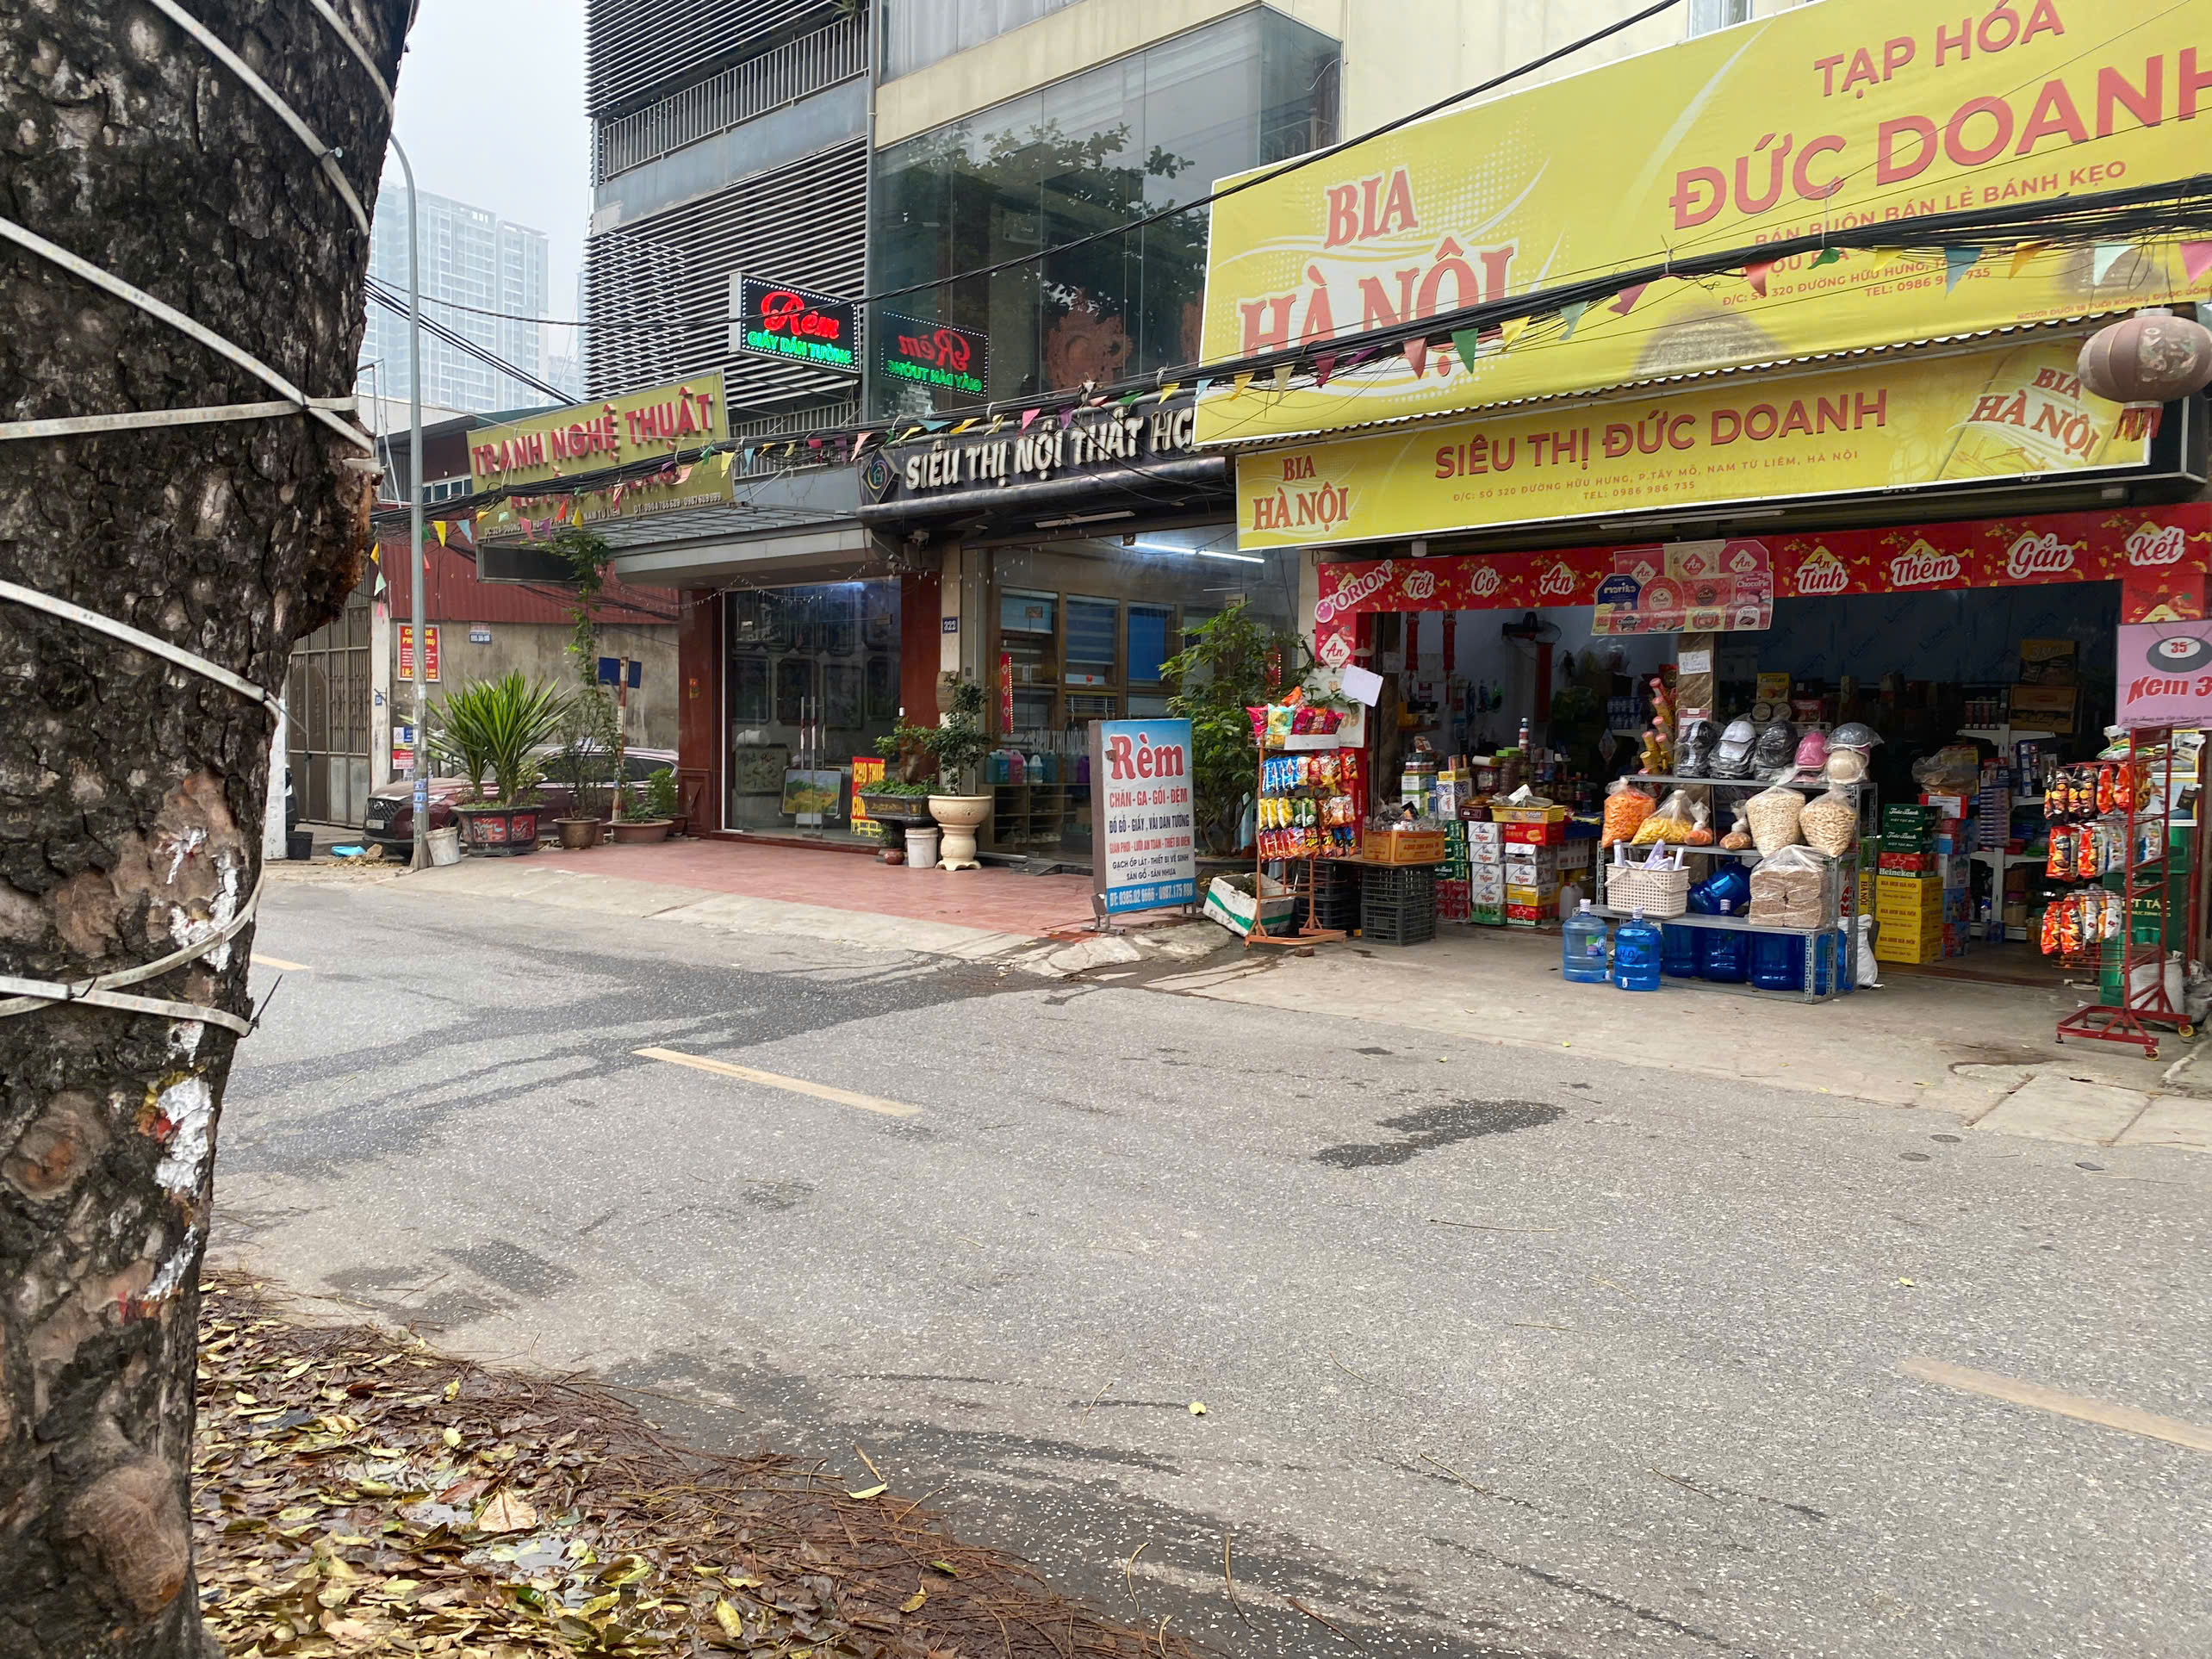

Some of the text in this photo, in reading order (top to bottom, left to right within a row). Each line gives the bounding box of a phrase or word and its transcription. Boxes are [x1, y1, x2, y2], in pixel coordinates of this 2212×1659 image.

[1814, 0, 2066, 100] TẠP HÓA
[1669, 132, 1847, 230] ĐỨC
[1809, 210, 1876, 238] BUÔN
[1884, 196, 1936, 222] BÁN
[1943, 184, 1976, 211] LẺ
[1983, 174, 2060, 208] BÁNH
[2068, 160, 2128, 196] KẸO
[1324, 169, 1420, 250] BIA
[1722, 294, 1748, 307] Đ/C:
[1771, 285, 1793, 297] 320
[1797, 274, 1846, 294] ĐƯỜNG
[1849, 267, 1880, 283] HỮU
[1864, 285, 1893, 298] TEL:
[1897, 277, 1932, 293] 0986
[1965, 267, 1991, 281] 735
[761, 290, 841, 339] Rèm
[1240, 236, 1515, 377] HÀ NỘI
[747, 329, 780, 351] GIẤY
[807, 343, 854, 364] TƯỜNG
[2031, 367, 2081, 400] BIA
[472, 385, 715, 476] TRANH NGHỆ THUẬT
[904, 438, 960, 491] SIÊU
[965, 440, 1008, 488] THỊ
[1013, 417, 1066, 482] NỘI
[1070, 407, 1145, 466] THẤT
[1434, 388, 1888, 479] SIÊU THỊ ĐỨC DOANH
[1969, 389, 2101, 462] HÀ NỘI
[1281, 456, 1317, 482] BIA
[1453, 492, 1476, 502] Đ/C:
[1497, 488, 1517, 497] 320
[1520, 482, 1561, 494] ĐƯỜNG
[1707, 463, 1737, 475] NAM
[1832, 449, 1860, 463] NỘI
[1583, 480, 1696, 500] TEL: 0986 986 735
[1252, 481, 1349, 532] HÀ NỘI
[1409, 527, 2184, 598] Tết Có An Tình Thêm Gắn Kết
[1335, 564, 1390, 609] ORION
[1325, 642, 1345, 658] An
[2171, 642, 2188, 653] 35
[2127, 676, 2190, 705] Kem
[854, 761, 867, 783] CHO
[1109, 733, 1185, 780] Rèm
[1137, 790, 1148, 806] GA
[1153, 784, 1165, 805] GỐI
[1171, 785, 1188, 807] ĐỆM
[1879, 867, 1917, 878] Heineken
